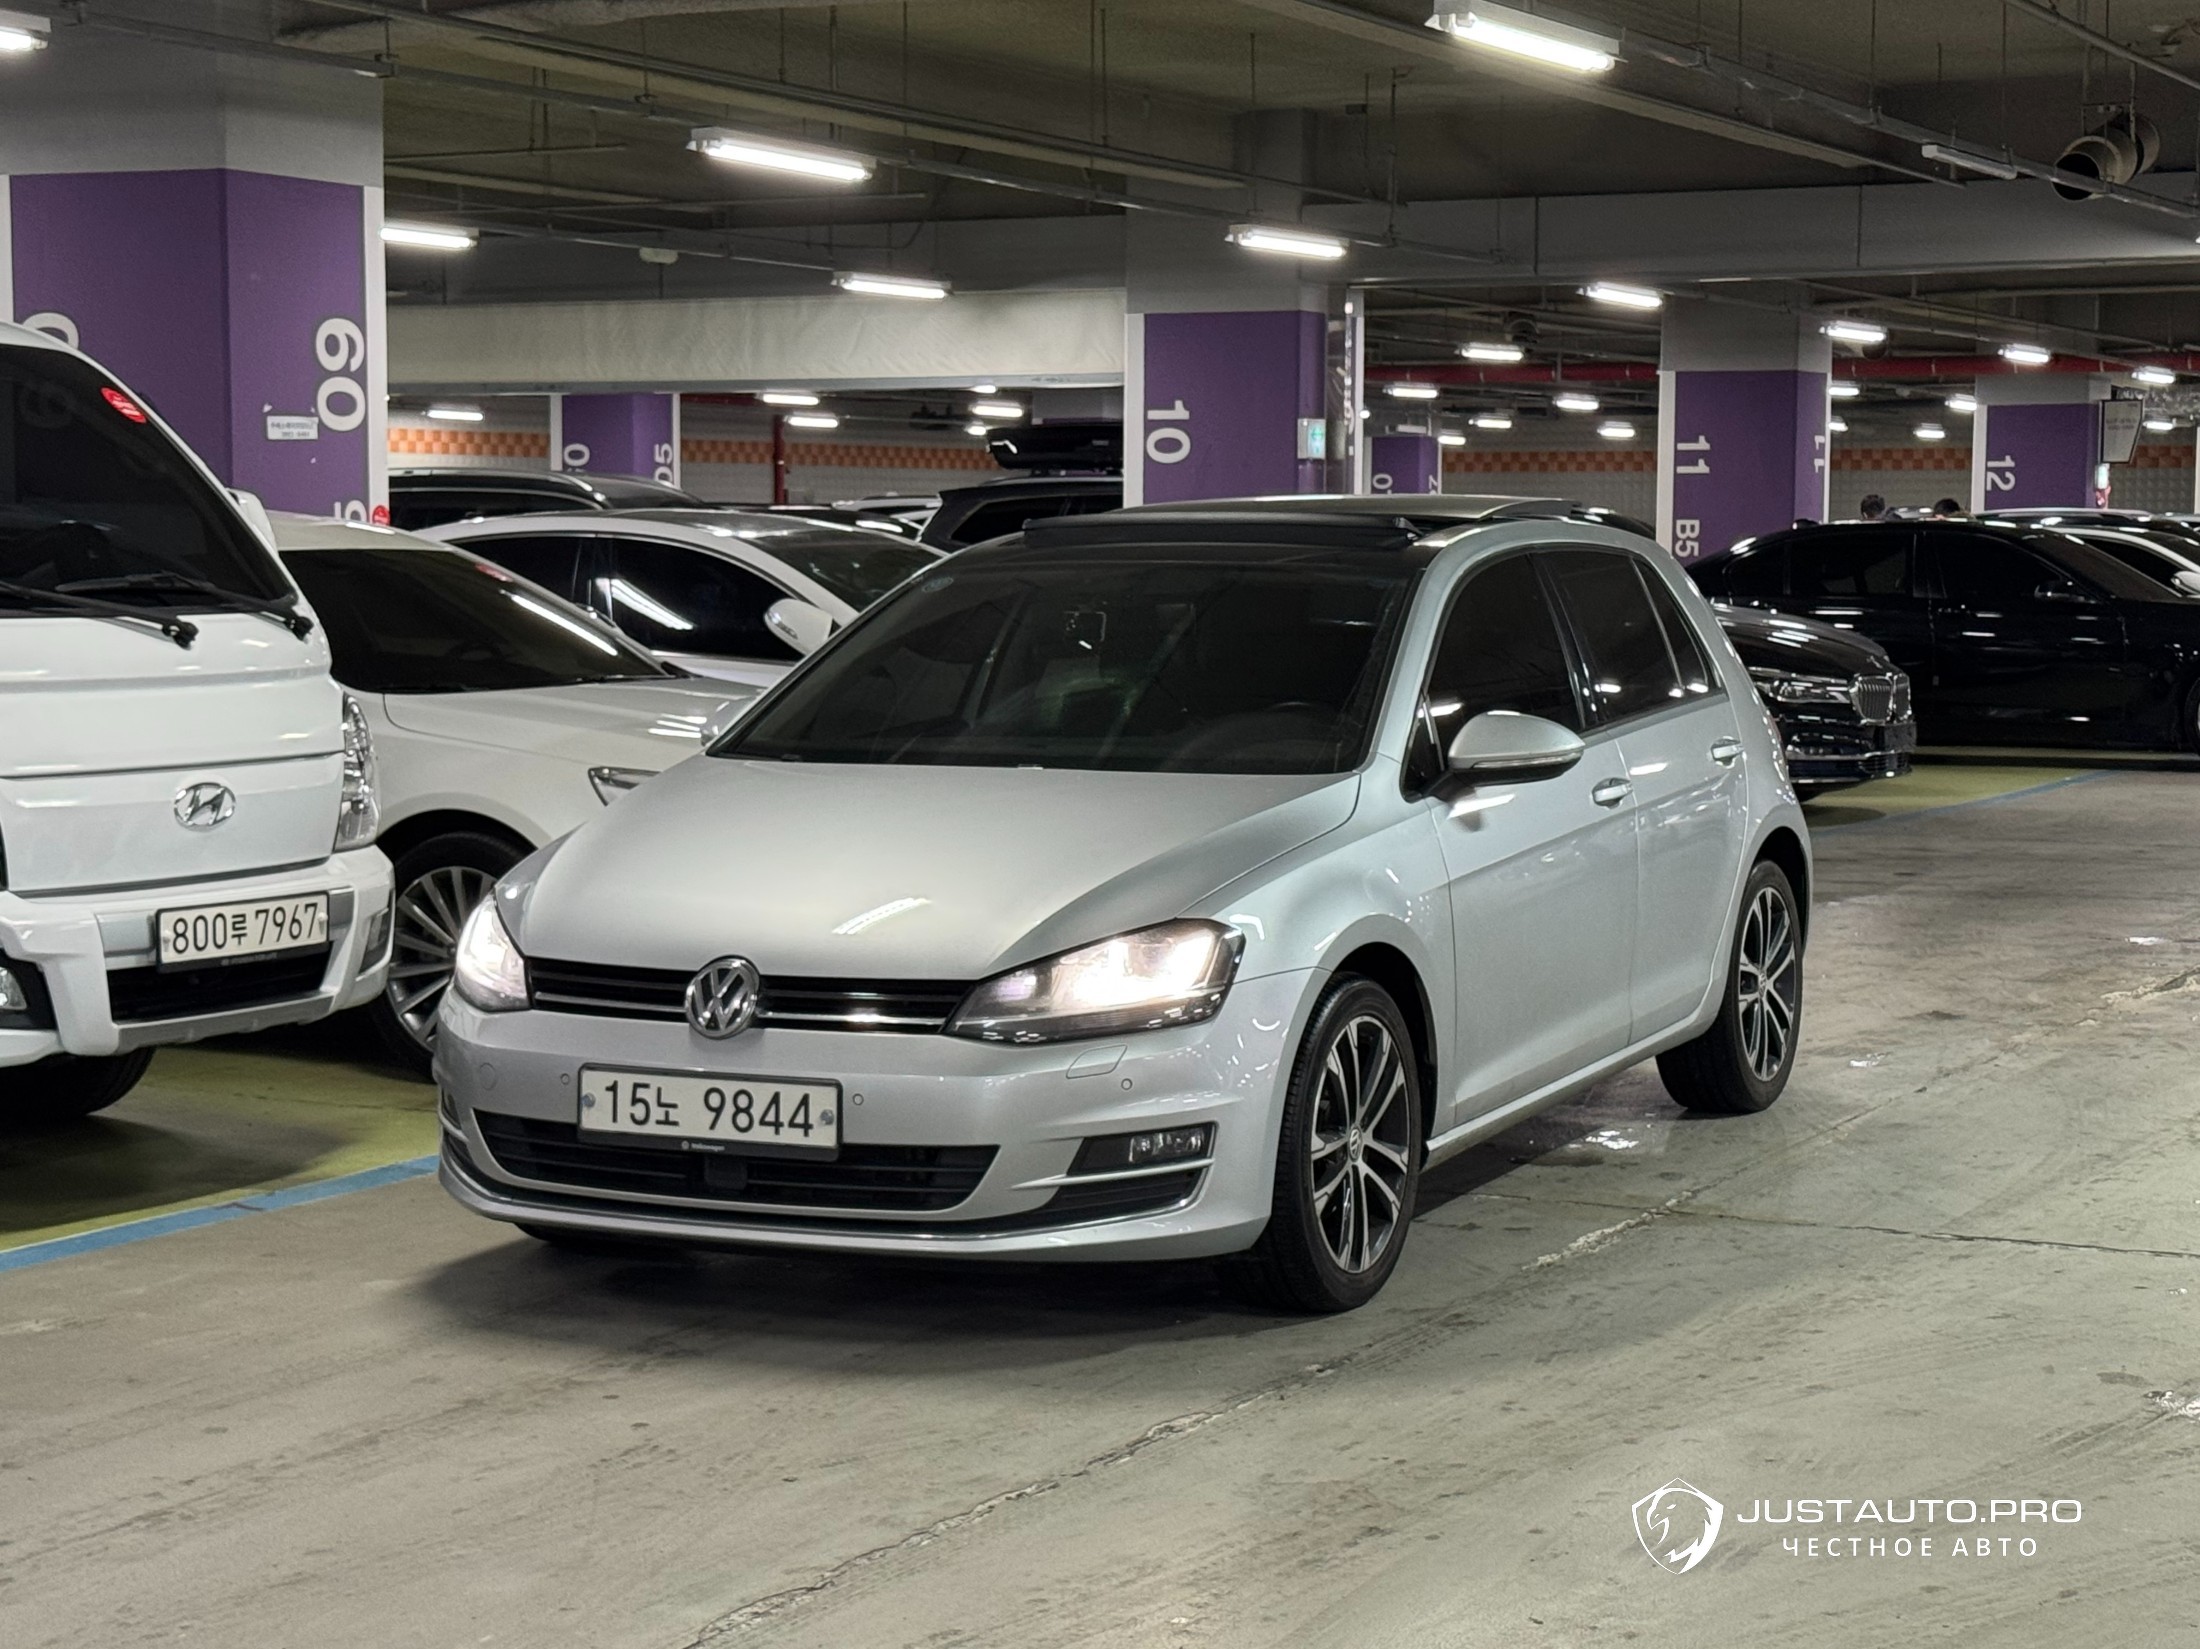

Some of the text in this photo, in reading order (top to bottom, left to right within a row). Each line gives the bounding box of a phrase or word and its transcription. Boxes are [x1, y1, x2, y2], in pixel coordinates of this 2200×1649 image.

[315, 317, 366, 432] 09
[1146, 399, 1191, 464] 10
[1676, 435, 1711, 474] 11
[1985, 455, 2016, 491] 12
[1674, 519, 1700, 557] B5
[604, 1079, 814, 1138] 15노 9844
